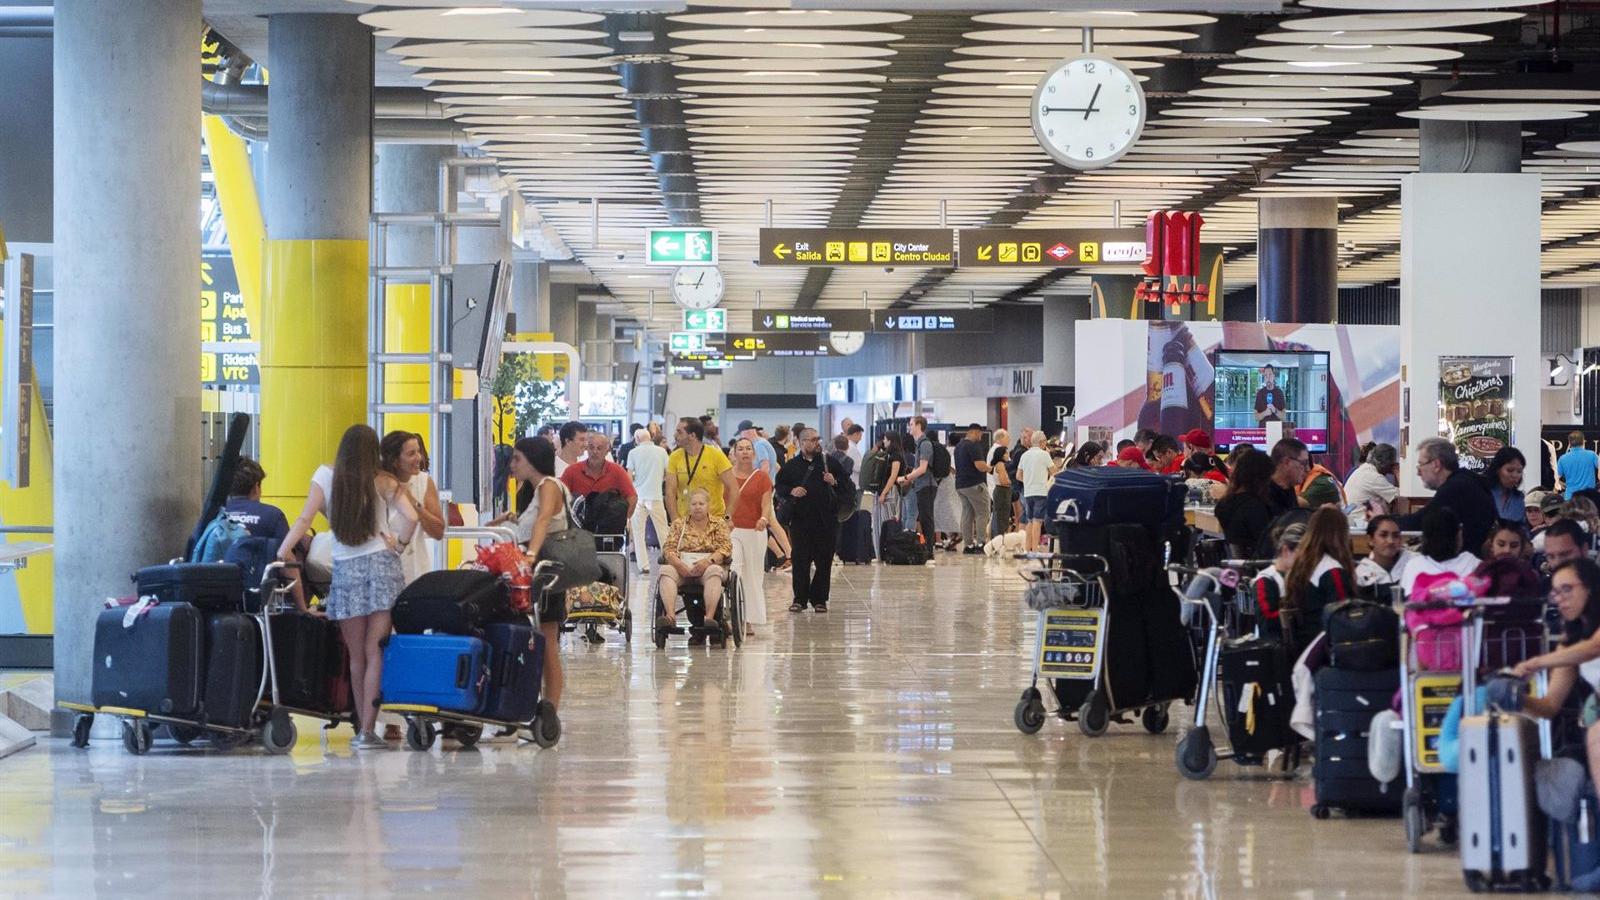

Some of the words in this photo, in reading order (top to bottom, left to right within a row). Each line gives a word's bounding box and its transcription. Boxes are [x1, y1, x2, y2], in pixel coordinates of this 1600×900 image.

[1084, 63, 1095, 73] 12
[1041, 105, 1050, 116] 9
[1129, 105, 1137, 116] 3
[1048, 129, 1054, 137] 8
[1065, 144, 1071, 152] 7
[1086, 147, 1094, 158] 6
[1109, 143, 1115, 151] 5
[795, 242, 809, 251] Exit
[894, 242, 905, 253] City
[907, 242, 929, 251] Center
[795, 251, 822, 260] Salida
[894, 252, 921, 261] Centro
[923, 251, 950, 261] Ciudad
[223, 323, 242, 335] Bus
[223, 354, 257, 366] Ridesh
[222, 366, 249, 380] VTC
[1012, 370, 1035, 394] PAUL
